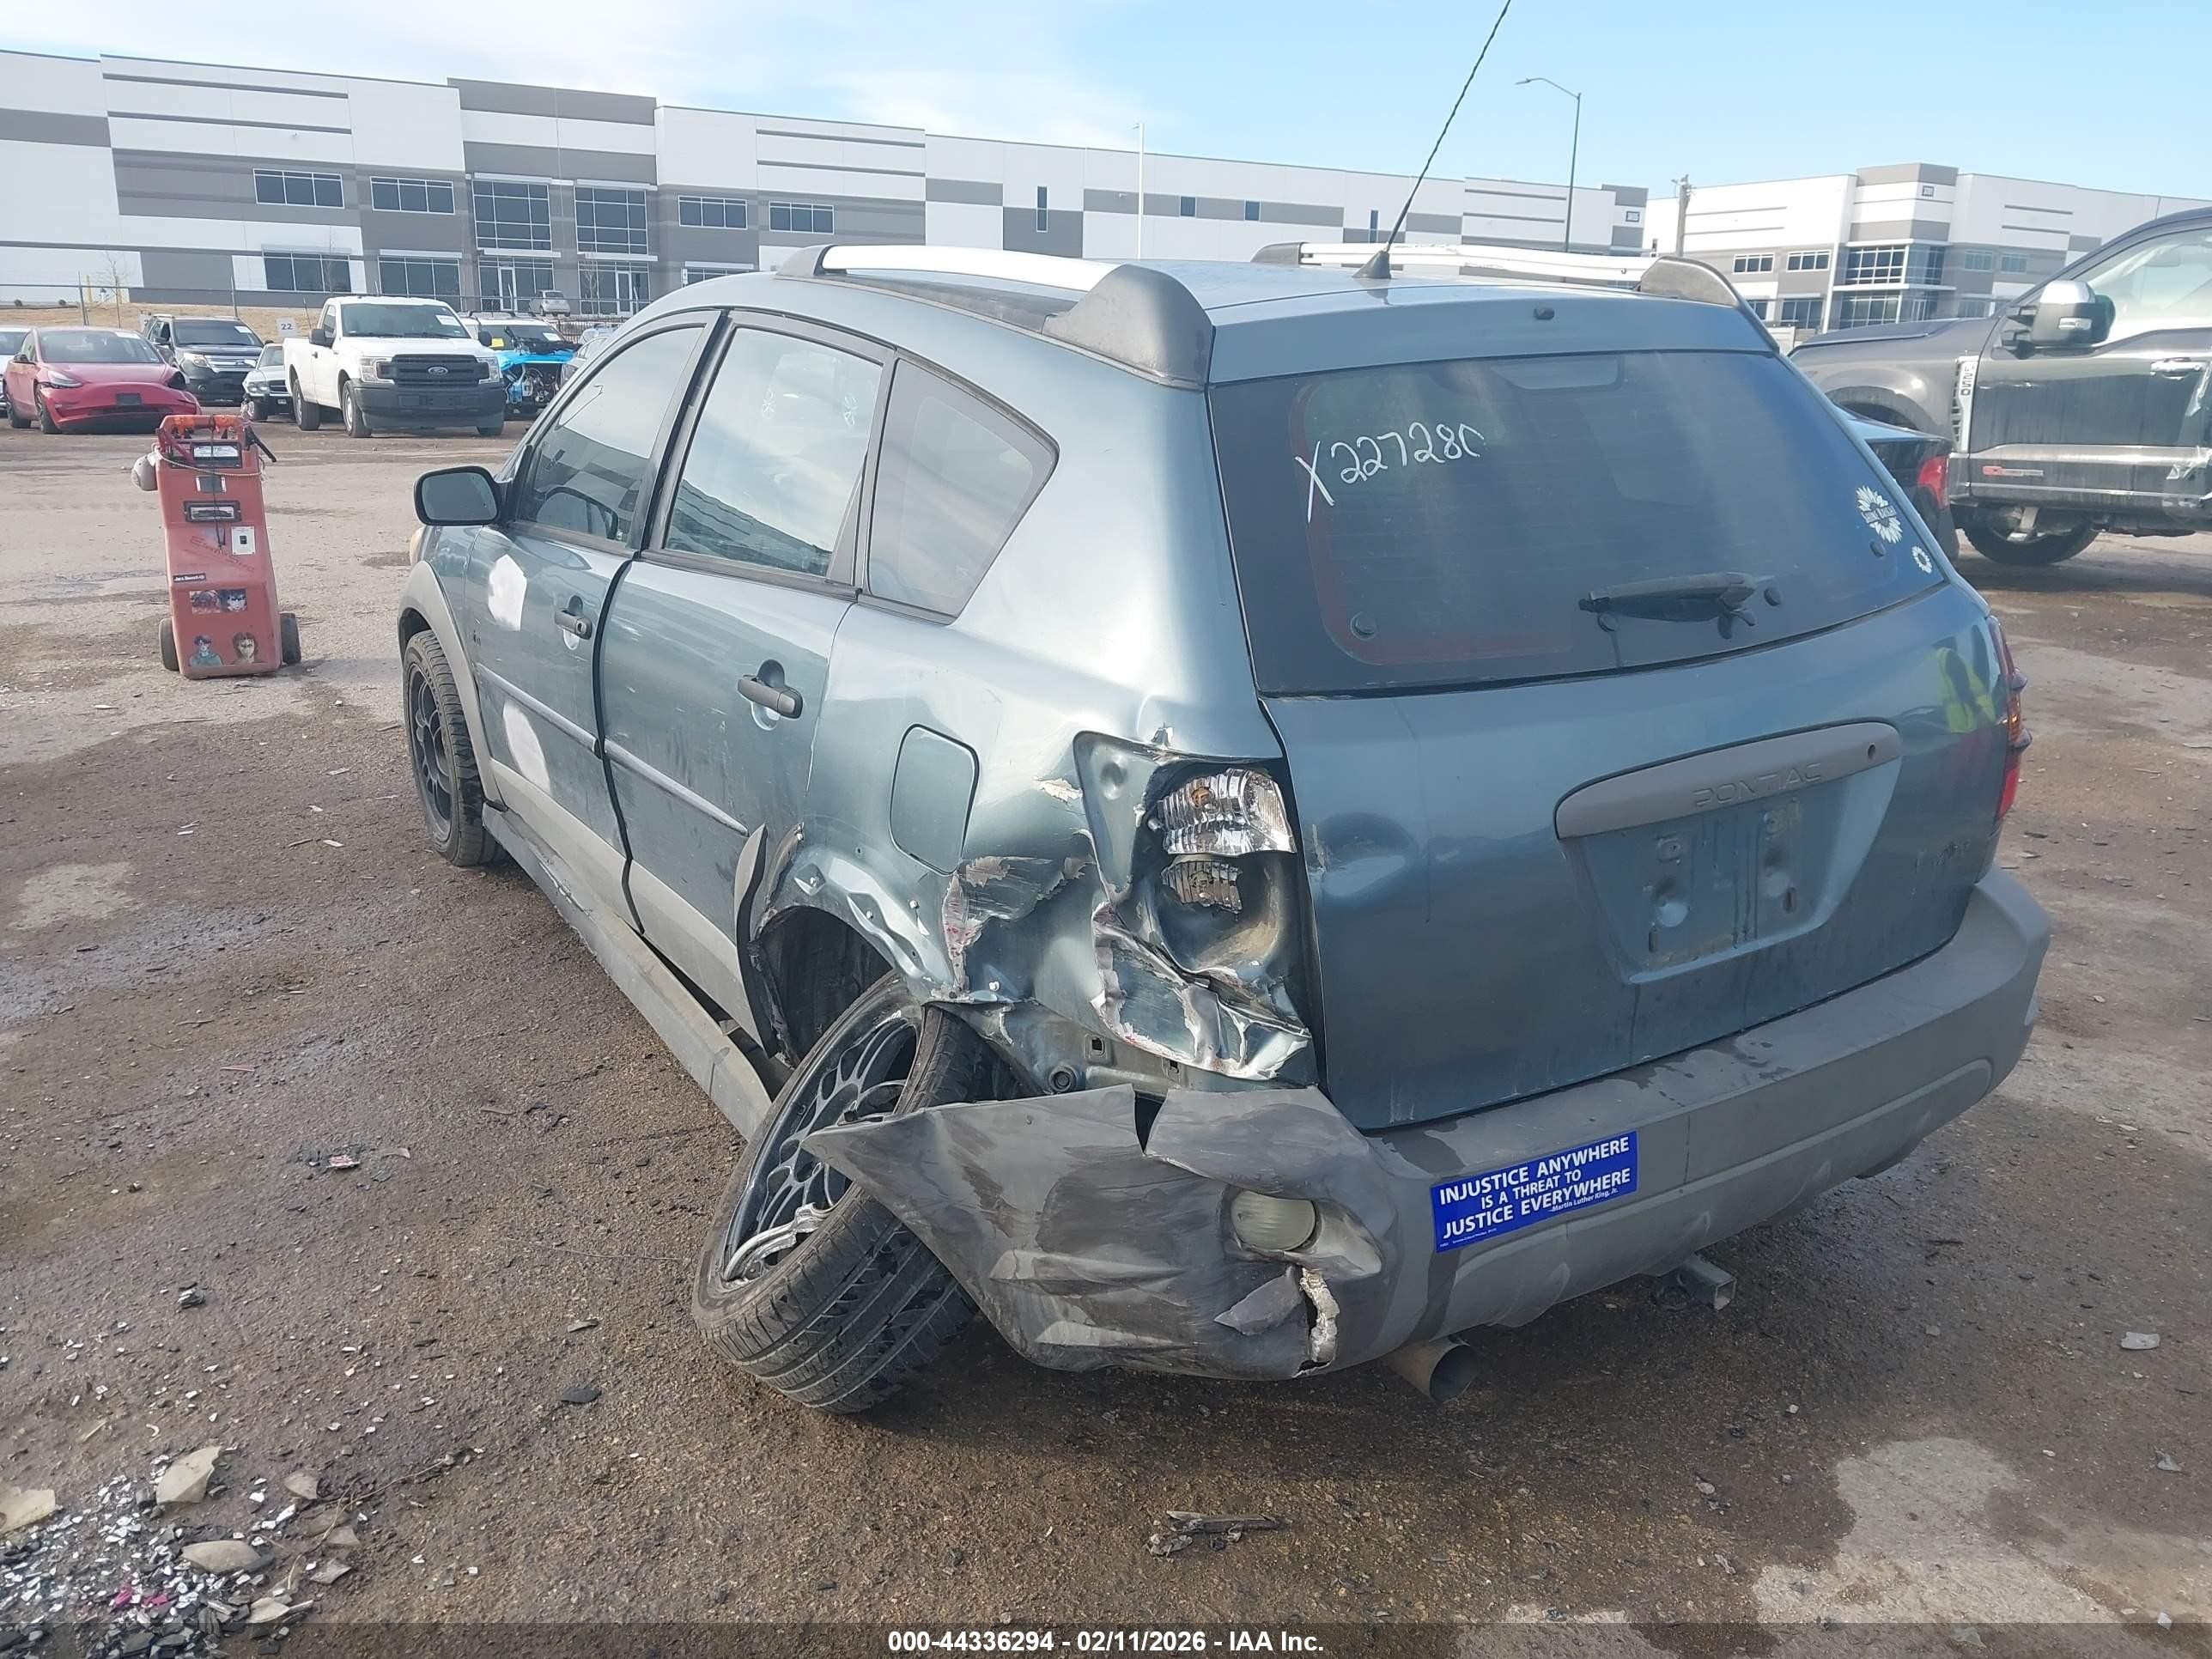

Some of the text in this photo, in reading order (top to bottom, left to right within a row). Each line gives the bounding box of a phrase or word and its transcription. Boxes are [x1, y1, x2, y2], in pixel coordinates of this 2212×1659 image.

[1692, 762, 1821, 808] PONTIAC
[1440, 1136, 1630, 1205] INJUSTICE ANYWHERE
[1481, 1169, 1581, 1209] IS A THREAT TO
[1443, 1168, 1631, 1239] JUSTICE EVERYWHERE
[1573, 1194, 1595, 1206] Luther
